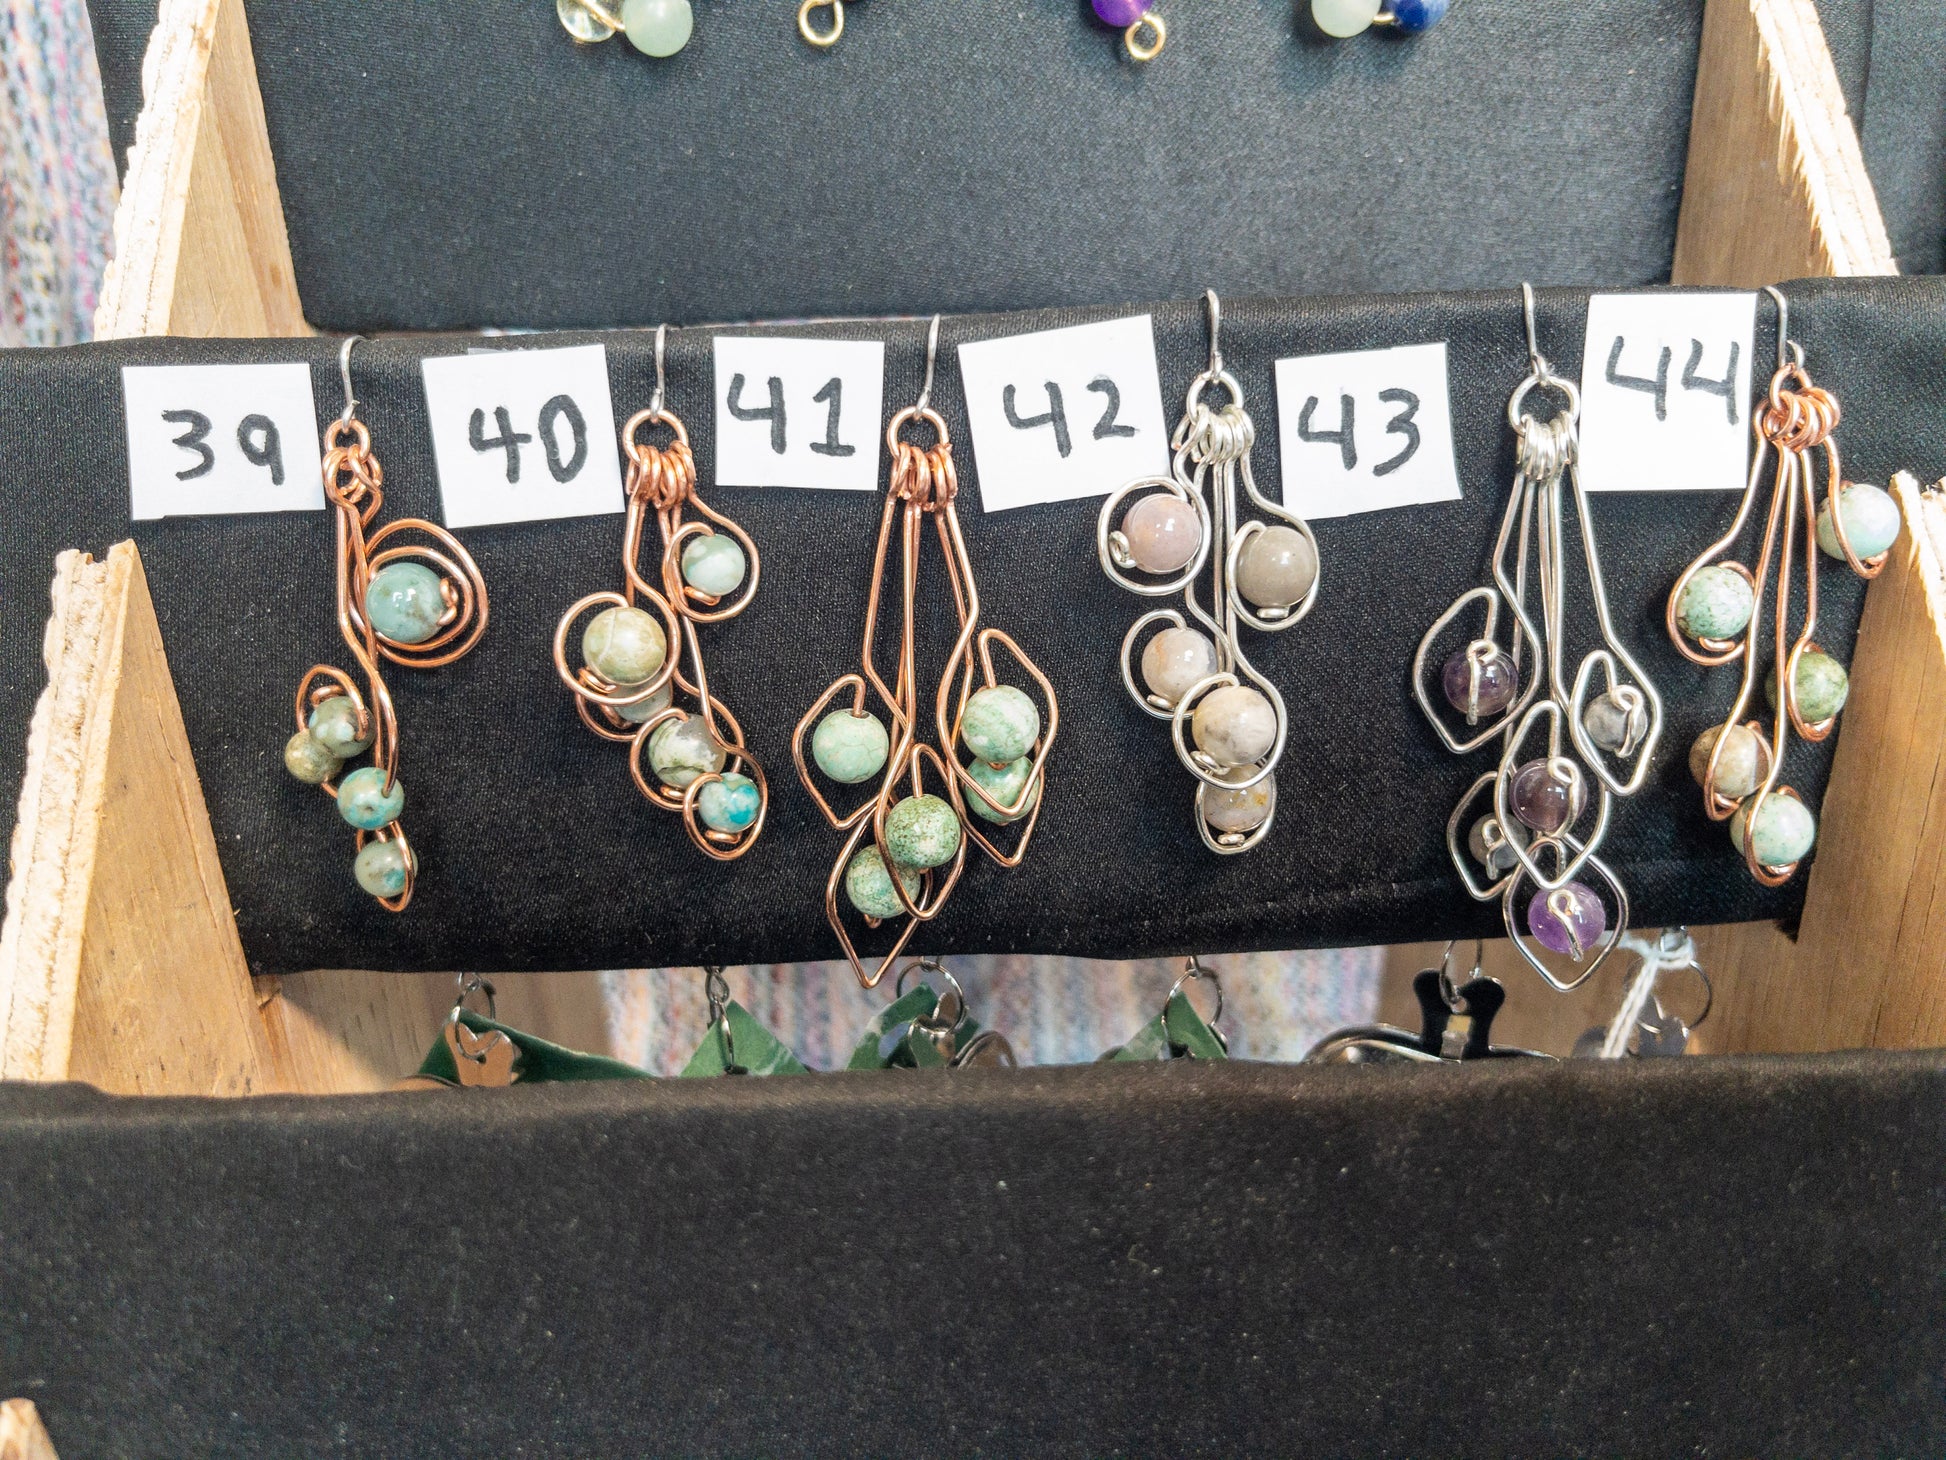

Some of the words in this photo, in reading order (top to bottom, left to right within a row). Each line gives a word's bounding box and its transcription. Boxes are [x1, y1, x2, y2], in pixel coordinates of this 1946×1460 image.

[726, 373, 856, 457] 41
[1002, 379, 1139, 458] 42
[1604, 335, 1740, 426] 44
[161, 410, 284, 486] 39
[468, 394, 587, 484] 40
[1297, 387, 1421, 476] 43
